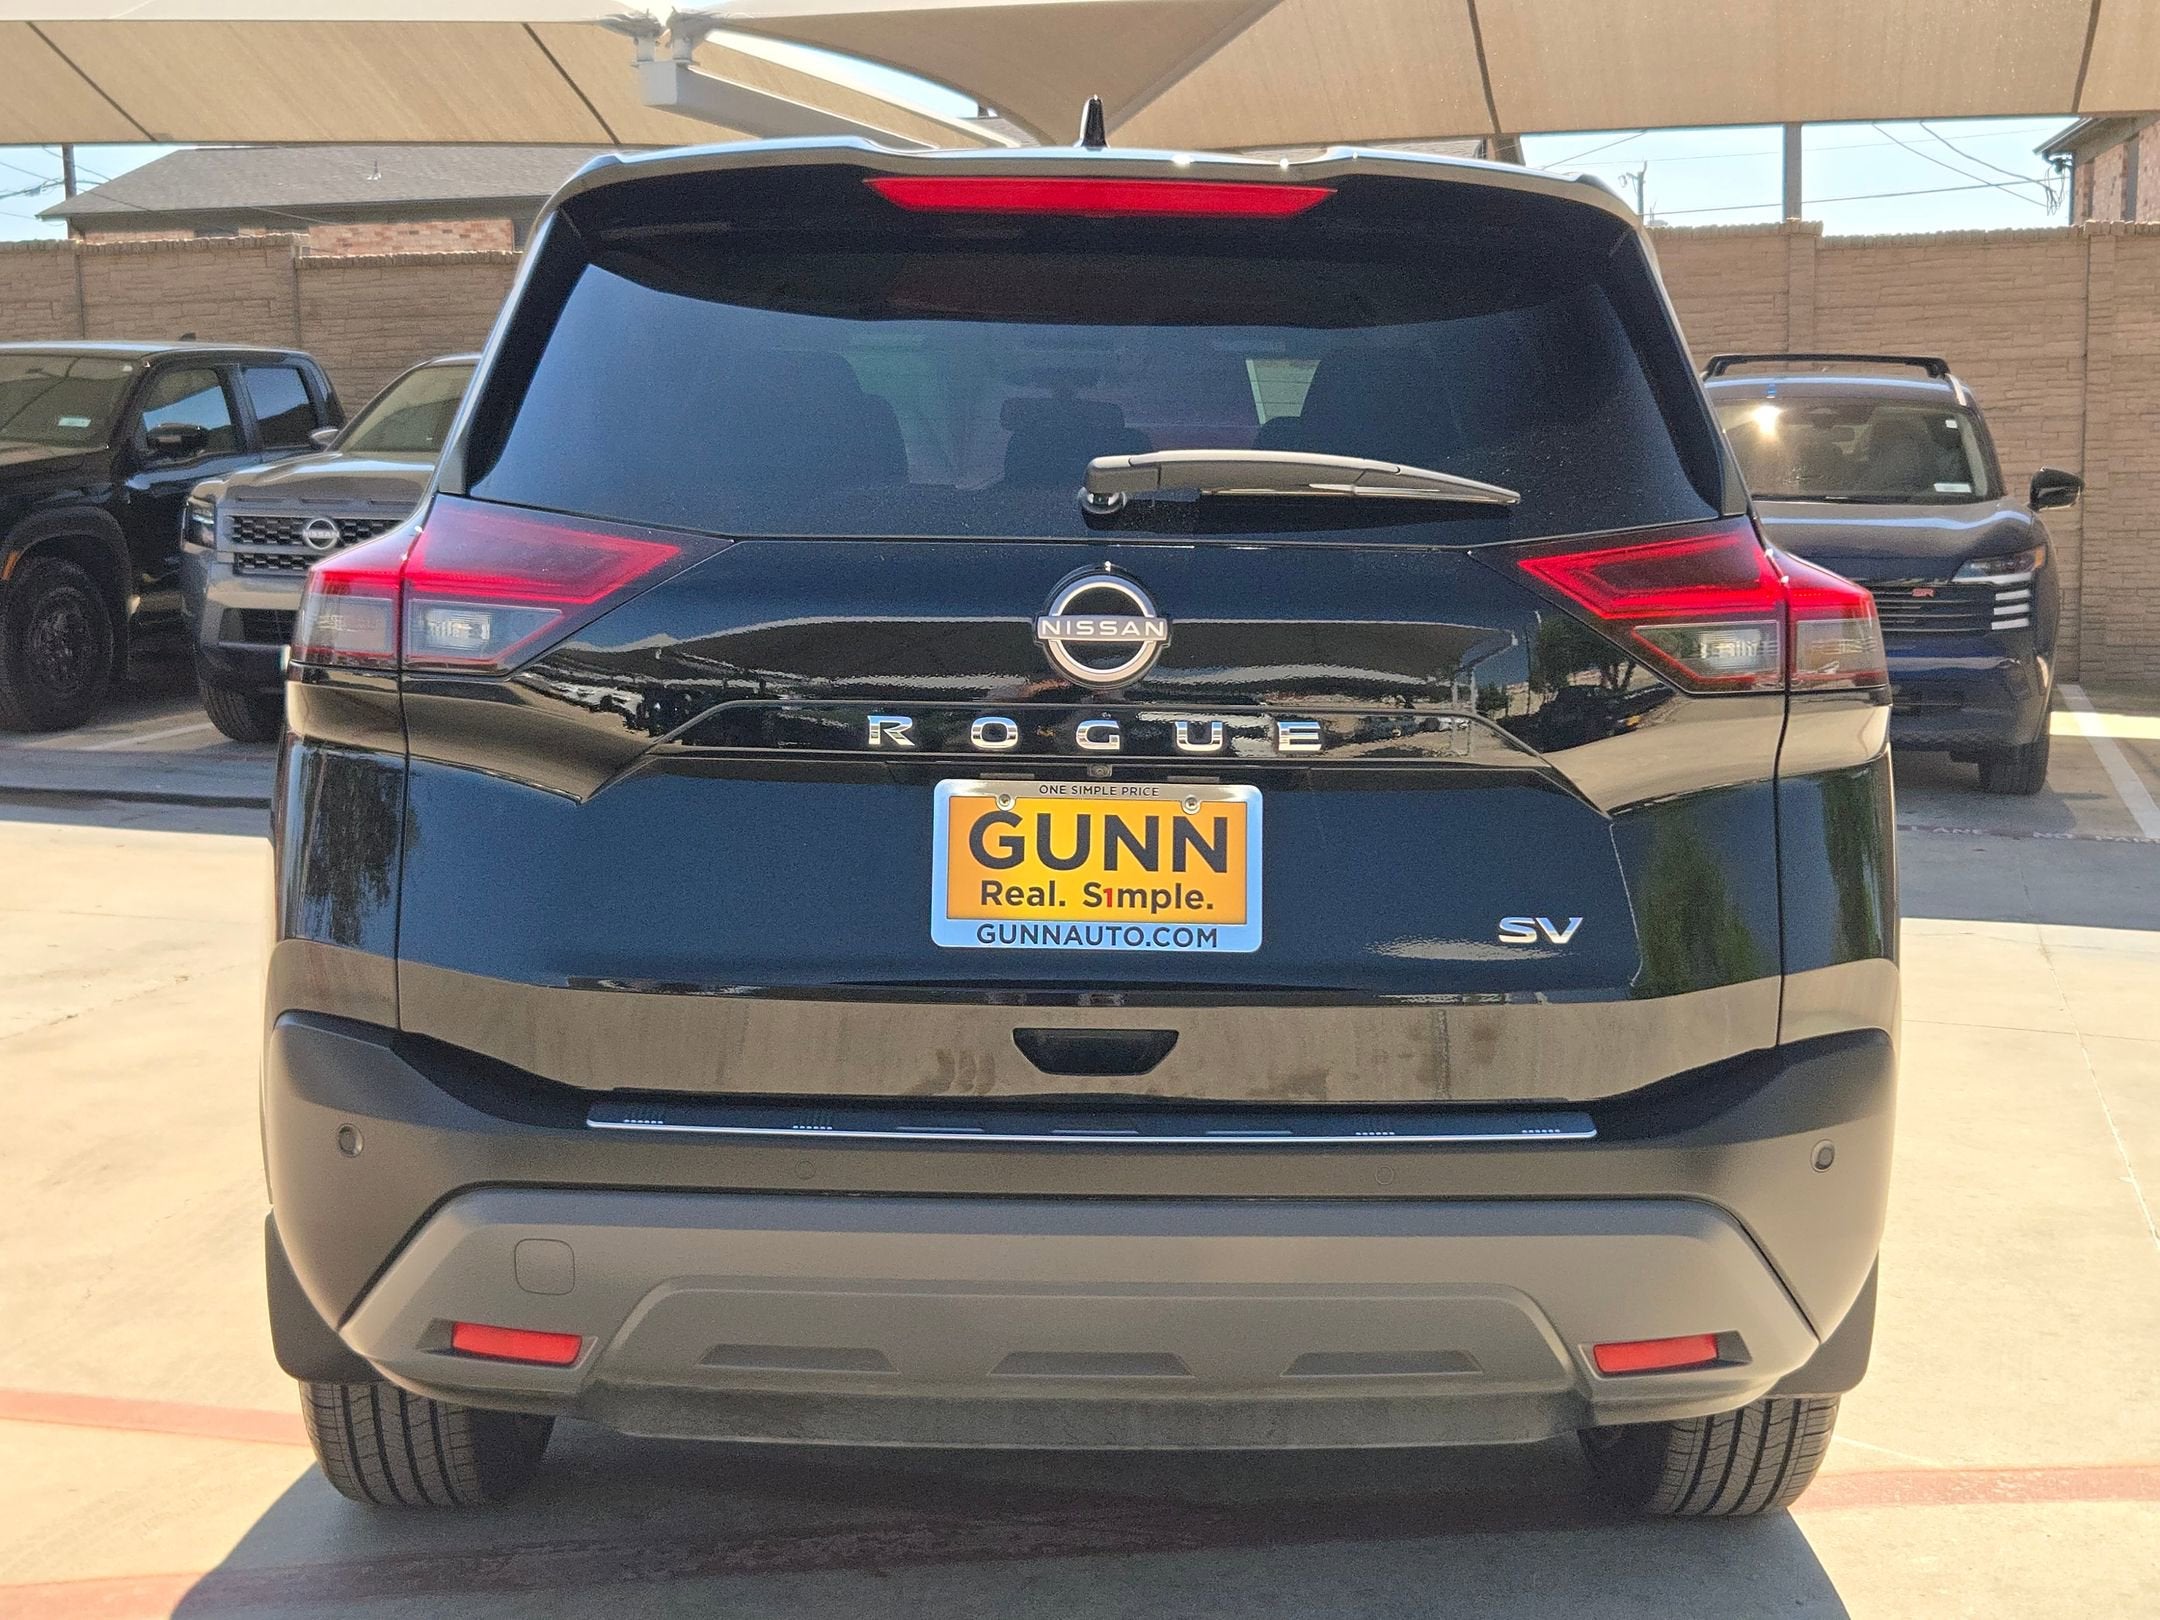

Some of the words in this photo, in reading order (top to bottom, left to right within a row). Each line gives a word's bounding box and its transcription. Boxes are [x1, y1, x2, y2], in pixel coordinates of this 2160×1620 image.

[1041, 620, 1164, 637] NISSAN
[867, 714, 1323, 752] ROGUE
[1039, 784, 1066, 795] ONE
[1071, 785, 1117, 796] SIMPLE
[1121, 786, 1160, 797] PRICE
[968, 809, 1228, 873] GUNN
[980, 879, 1066, 907] Real.
[1082, 881, 1214, 914] S1mple.
[976, 923, 1218, 949] GUNNAUTO.COM
[1498, 916, 1584, 944] SV
